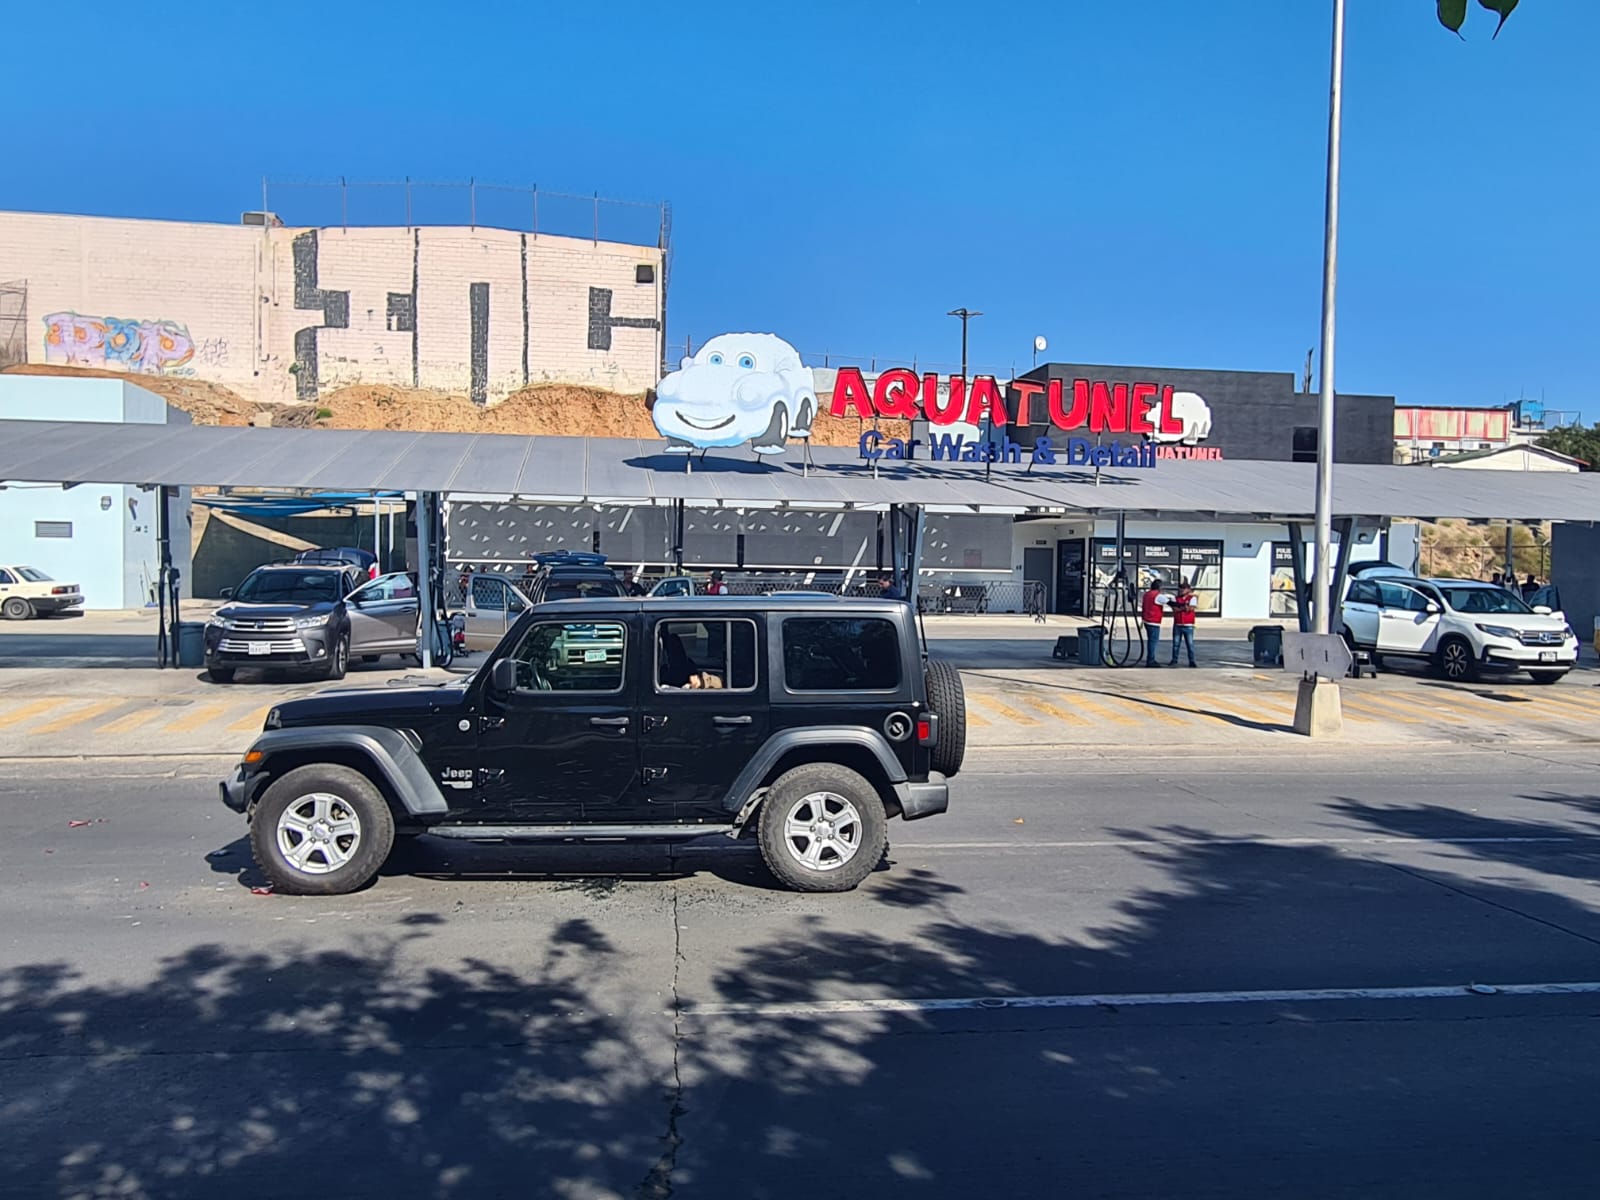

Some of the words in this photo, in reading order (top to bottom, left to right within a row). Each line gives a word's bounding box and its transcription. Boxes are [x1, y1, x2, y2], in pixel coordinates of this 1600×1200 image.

[830, 366, 1184, 434] AQUATUNEL
[859, 430, 920, 460] Car
[929, 433, 1022, 464] Wash
[1032, 436, 1056, 465] &
[1067, 437, 1156, 468] Detail
[1133, 445, 1223, 461] UATUNEL
[441, 767, 472, 780] Jeep
